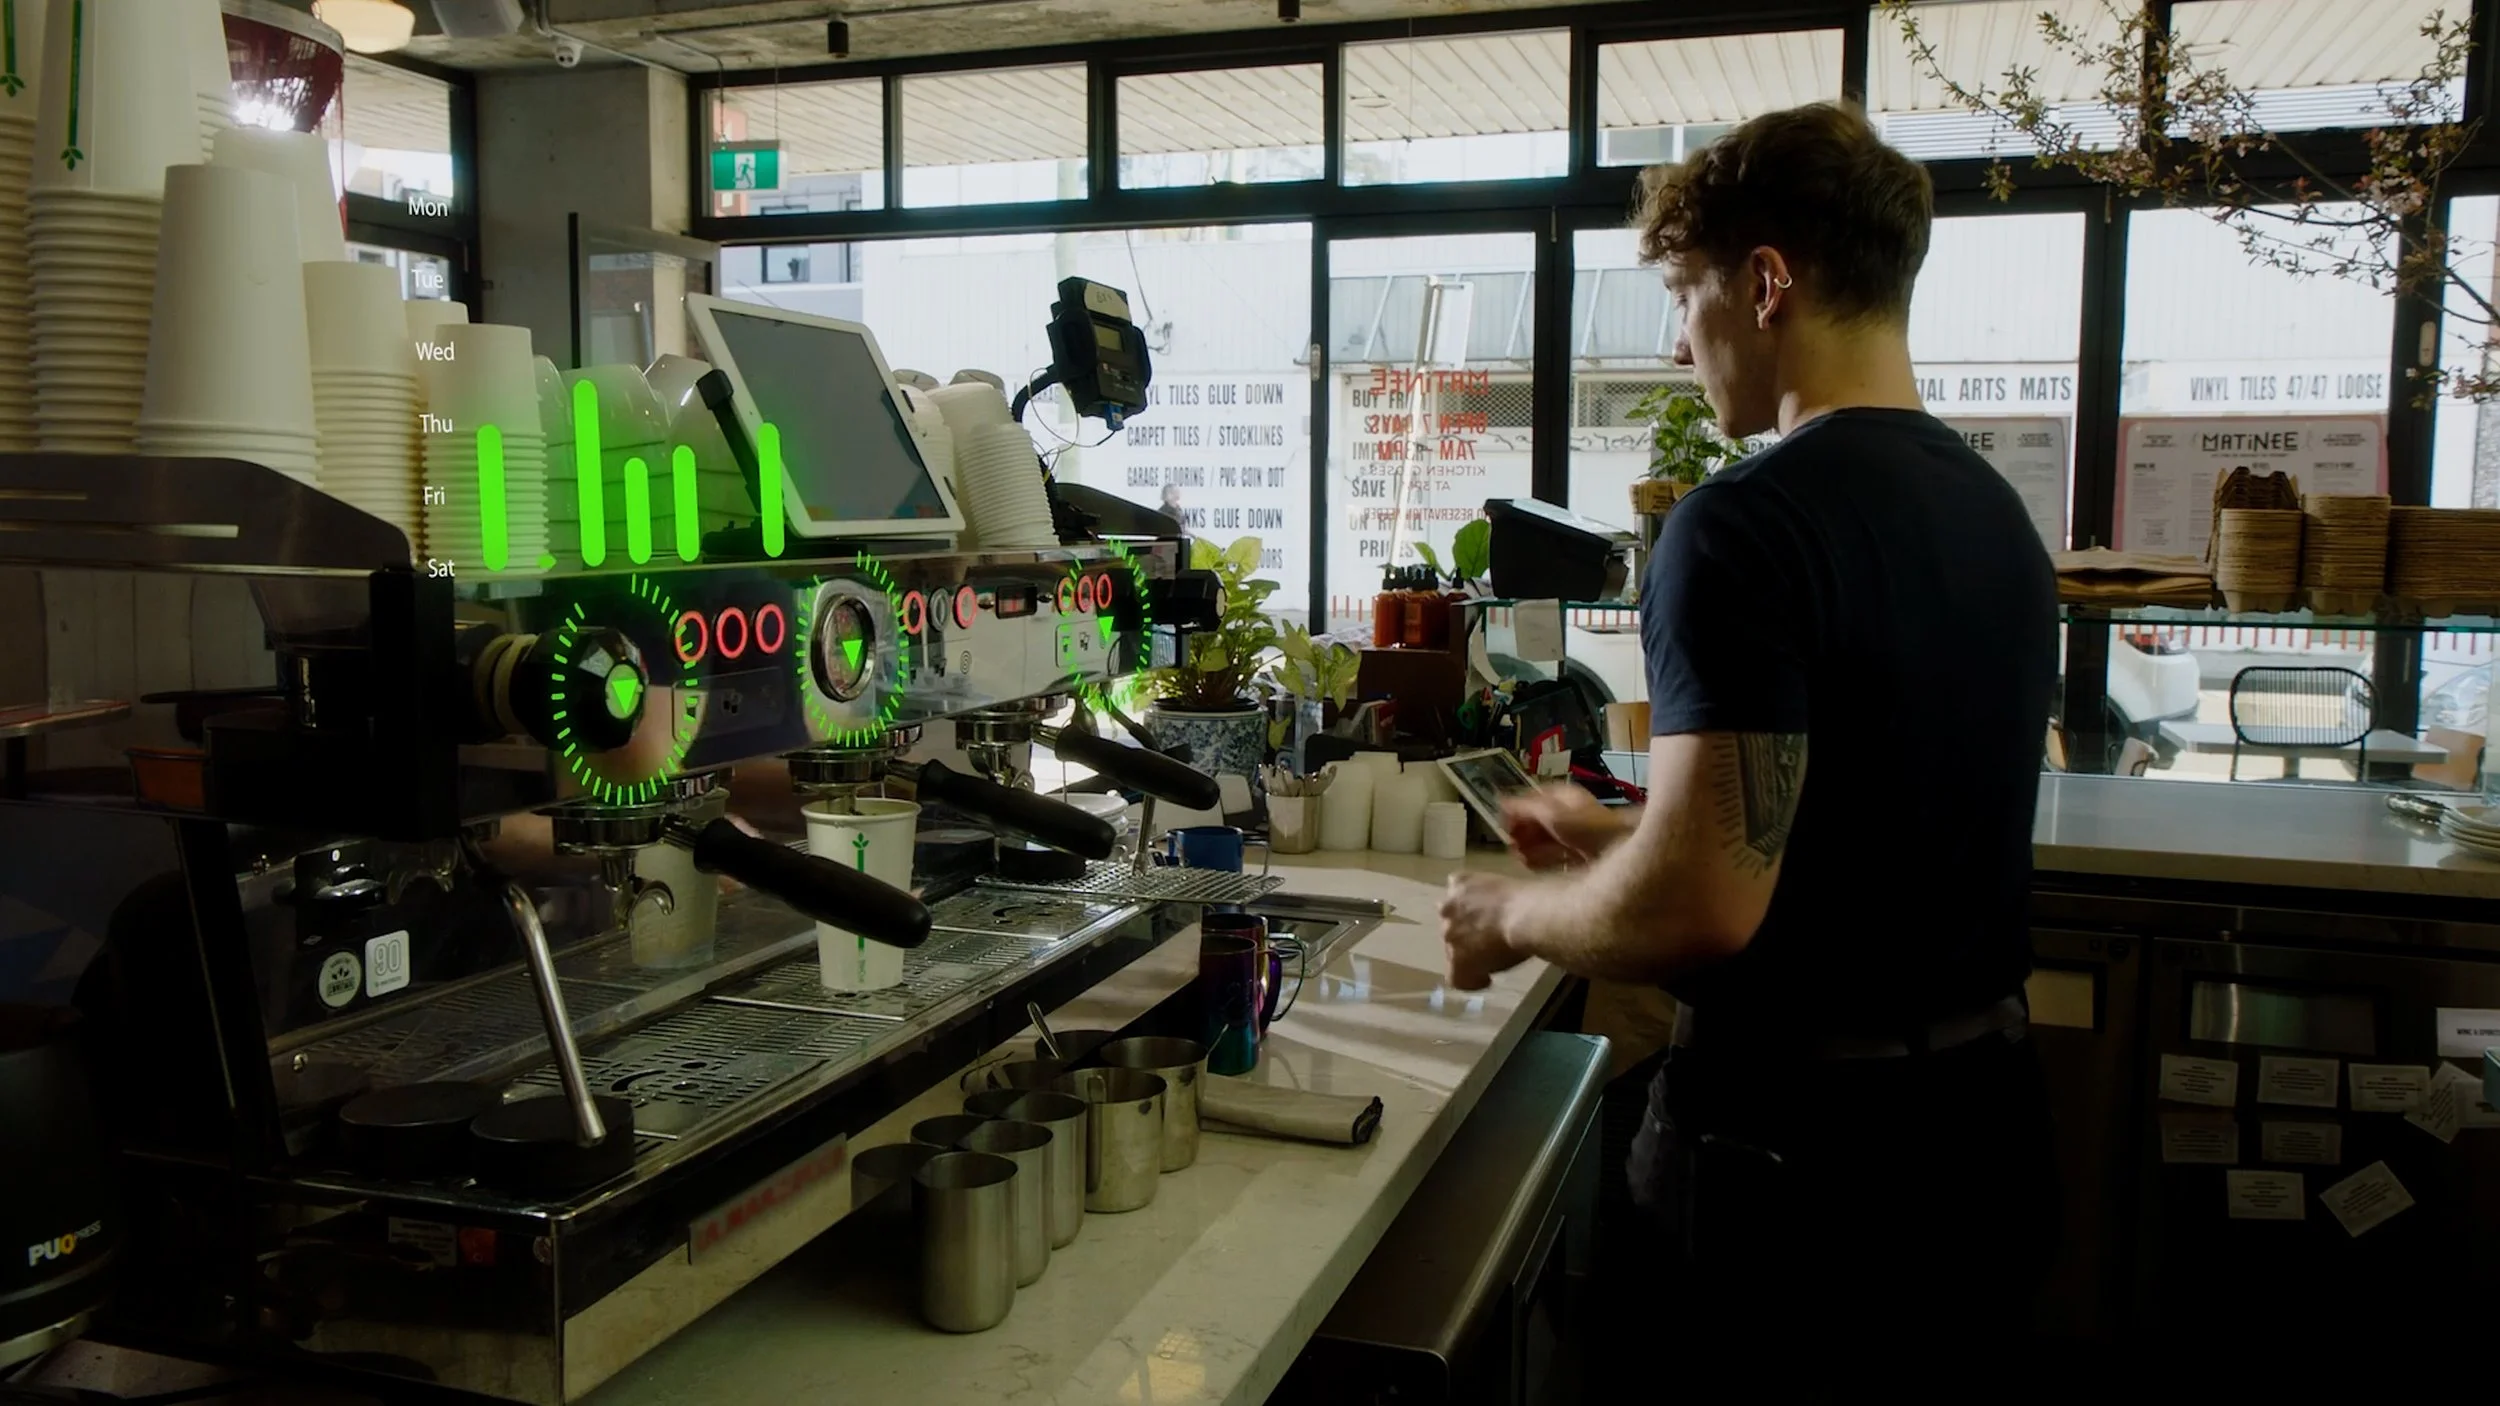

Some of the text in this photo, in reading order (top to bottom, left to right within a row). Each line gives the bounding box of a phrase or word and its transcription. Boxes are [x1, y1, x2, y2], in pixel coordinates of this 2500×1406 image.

[1169, 384, 1200, 405] TILES
[1208, 384, 1236, 405] GLUE
[1246, 383, 1283, 404] DOWN
[1959, 377, 2006, 401] ARTS
[2020, 376, 2072, 401] MATS
[2191, 373, 2383, 401] VINYL TILES 47/47 LOOSE
[1127, 426, 1166, 447] CARPET
[1173, 426, 1200, 446] TILES
[1219, 425, 1283, 447] STOCKLINES
[1127, 467, 1160, 487] GARAGE
[1165, 467, 1205, 487] FLOORING
[1220, 467, 1237, 487] PVC
[1268, 467, 1285, 487] DOT
[1352, 477, 1386, 498] SAVE
[1184, 508, 1282, 529] NKS GLUE DOWN
[1360, 540, 1414, 558] PRIES
[375, 939, 402, 976] 90
